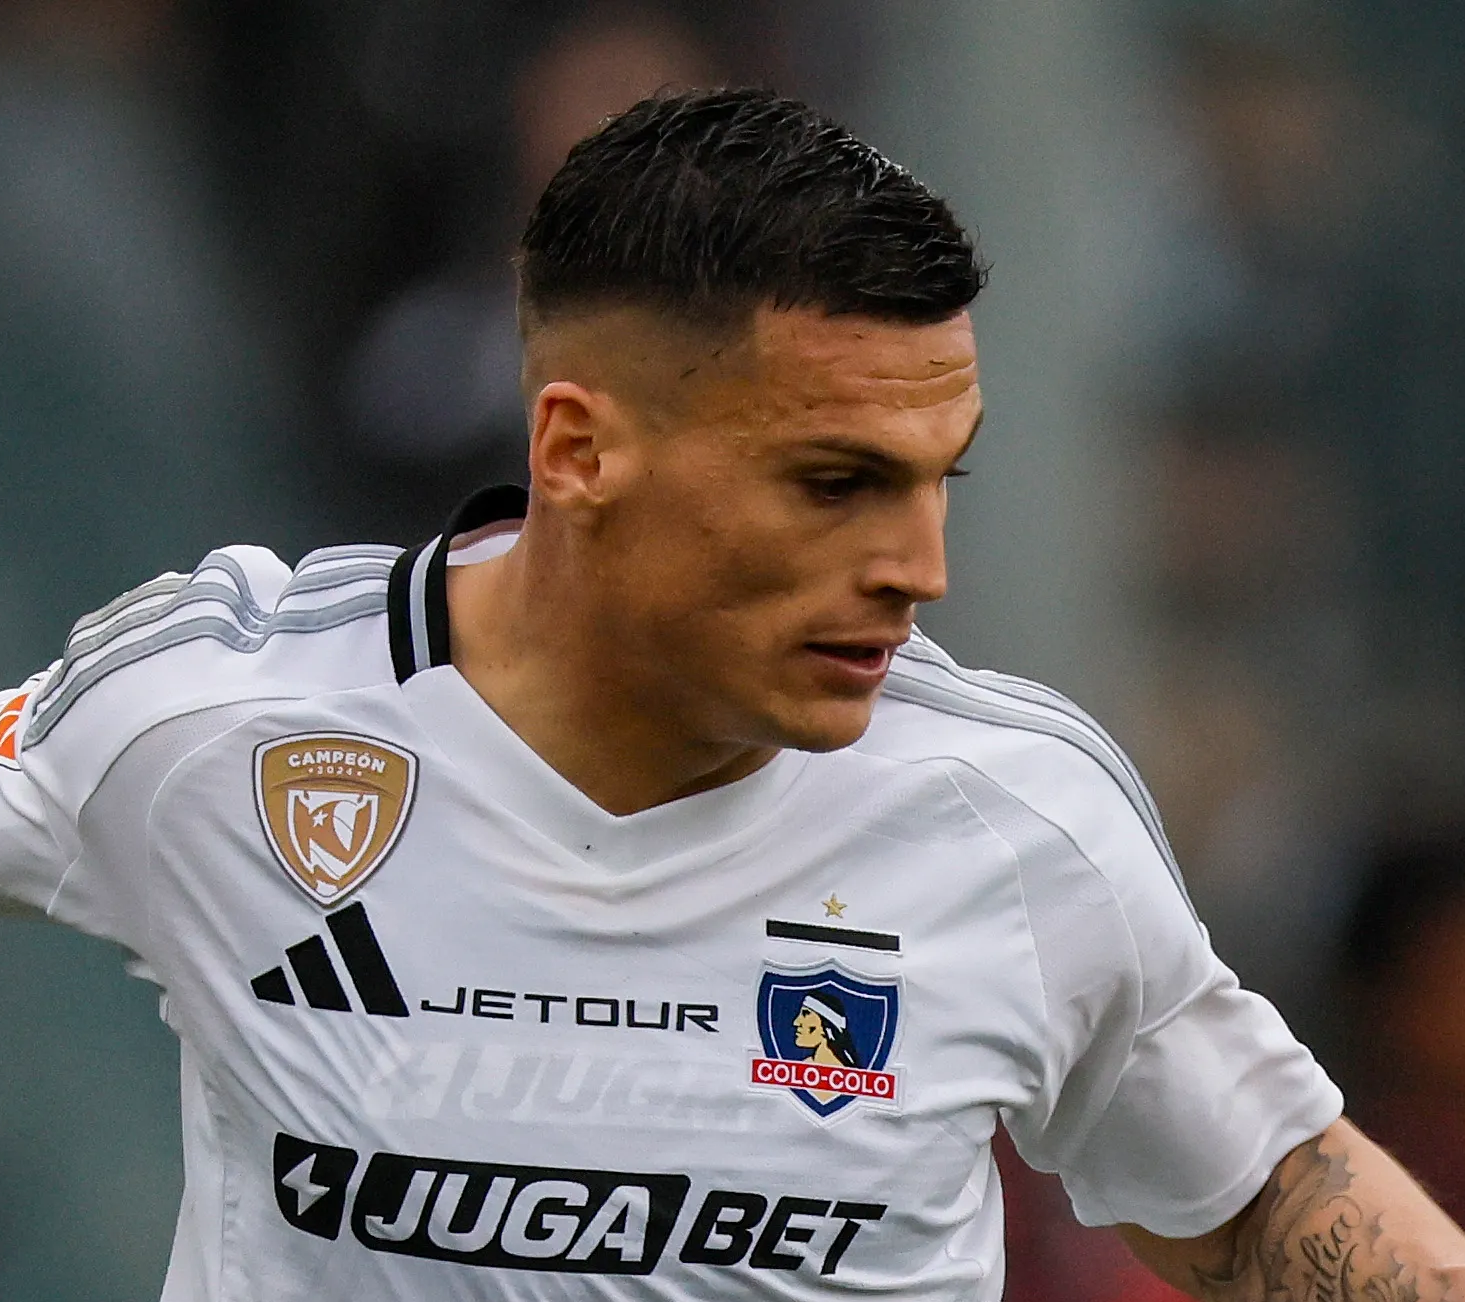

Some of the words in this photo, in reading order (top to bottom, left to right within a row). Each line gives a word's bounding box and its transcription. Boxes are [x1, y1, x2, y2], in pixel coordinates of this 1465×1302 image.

[288, 750, 386, 773] CAMPEÓN
[421, 987, 719, 1033] JETOUR
[757, 1062, 890, 1095] COLO-COLO
